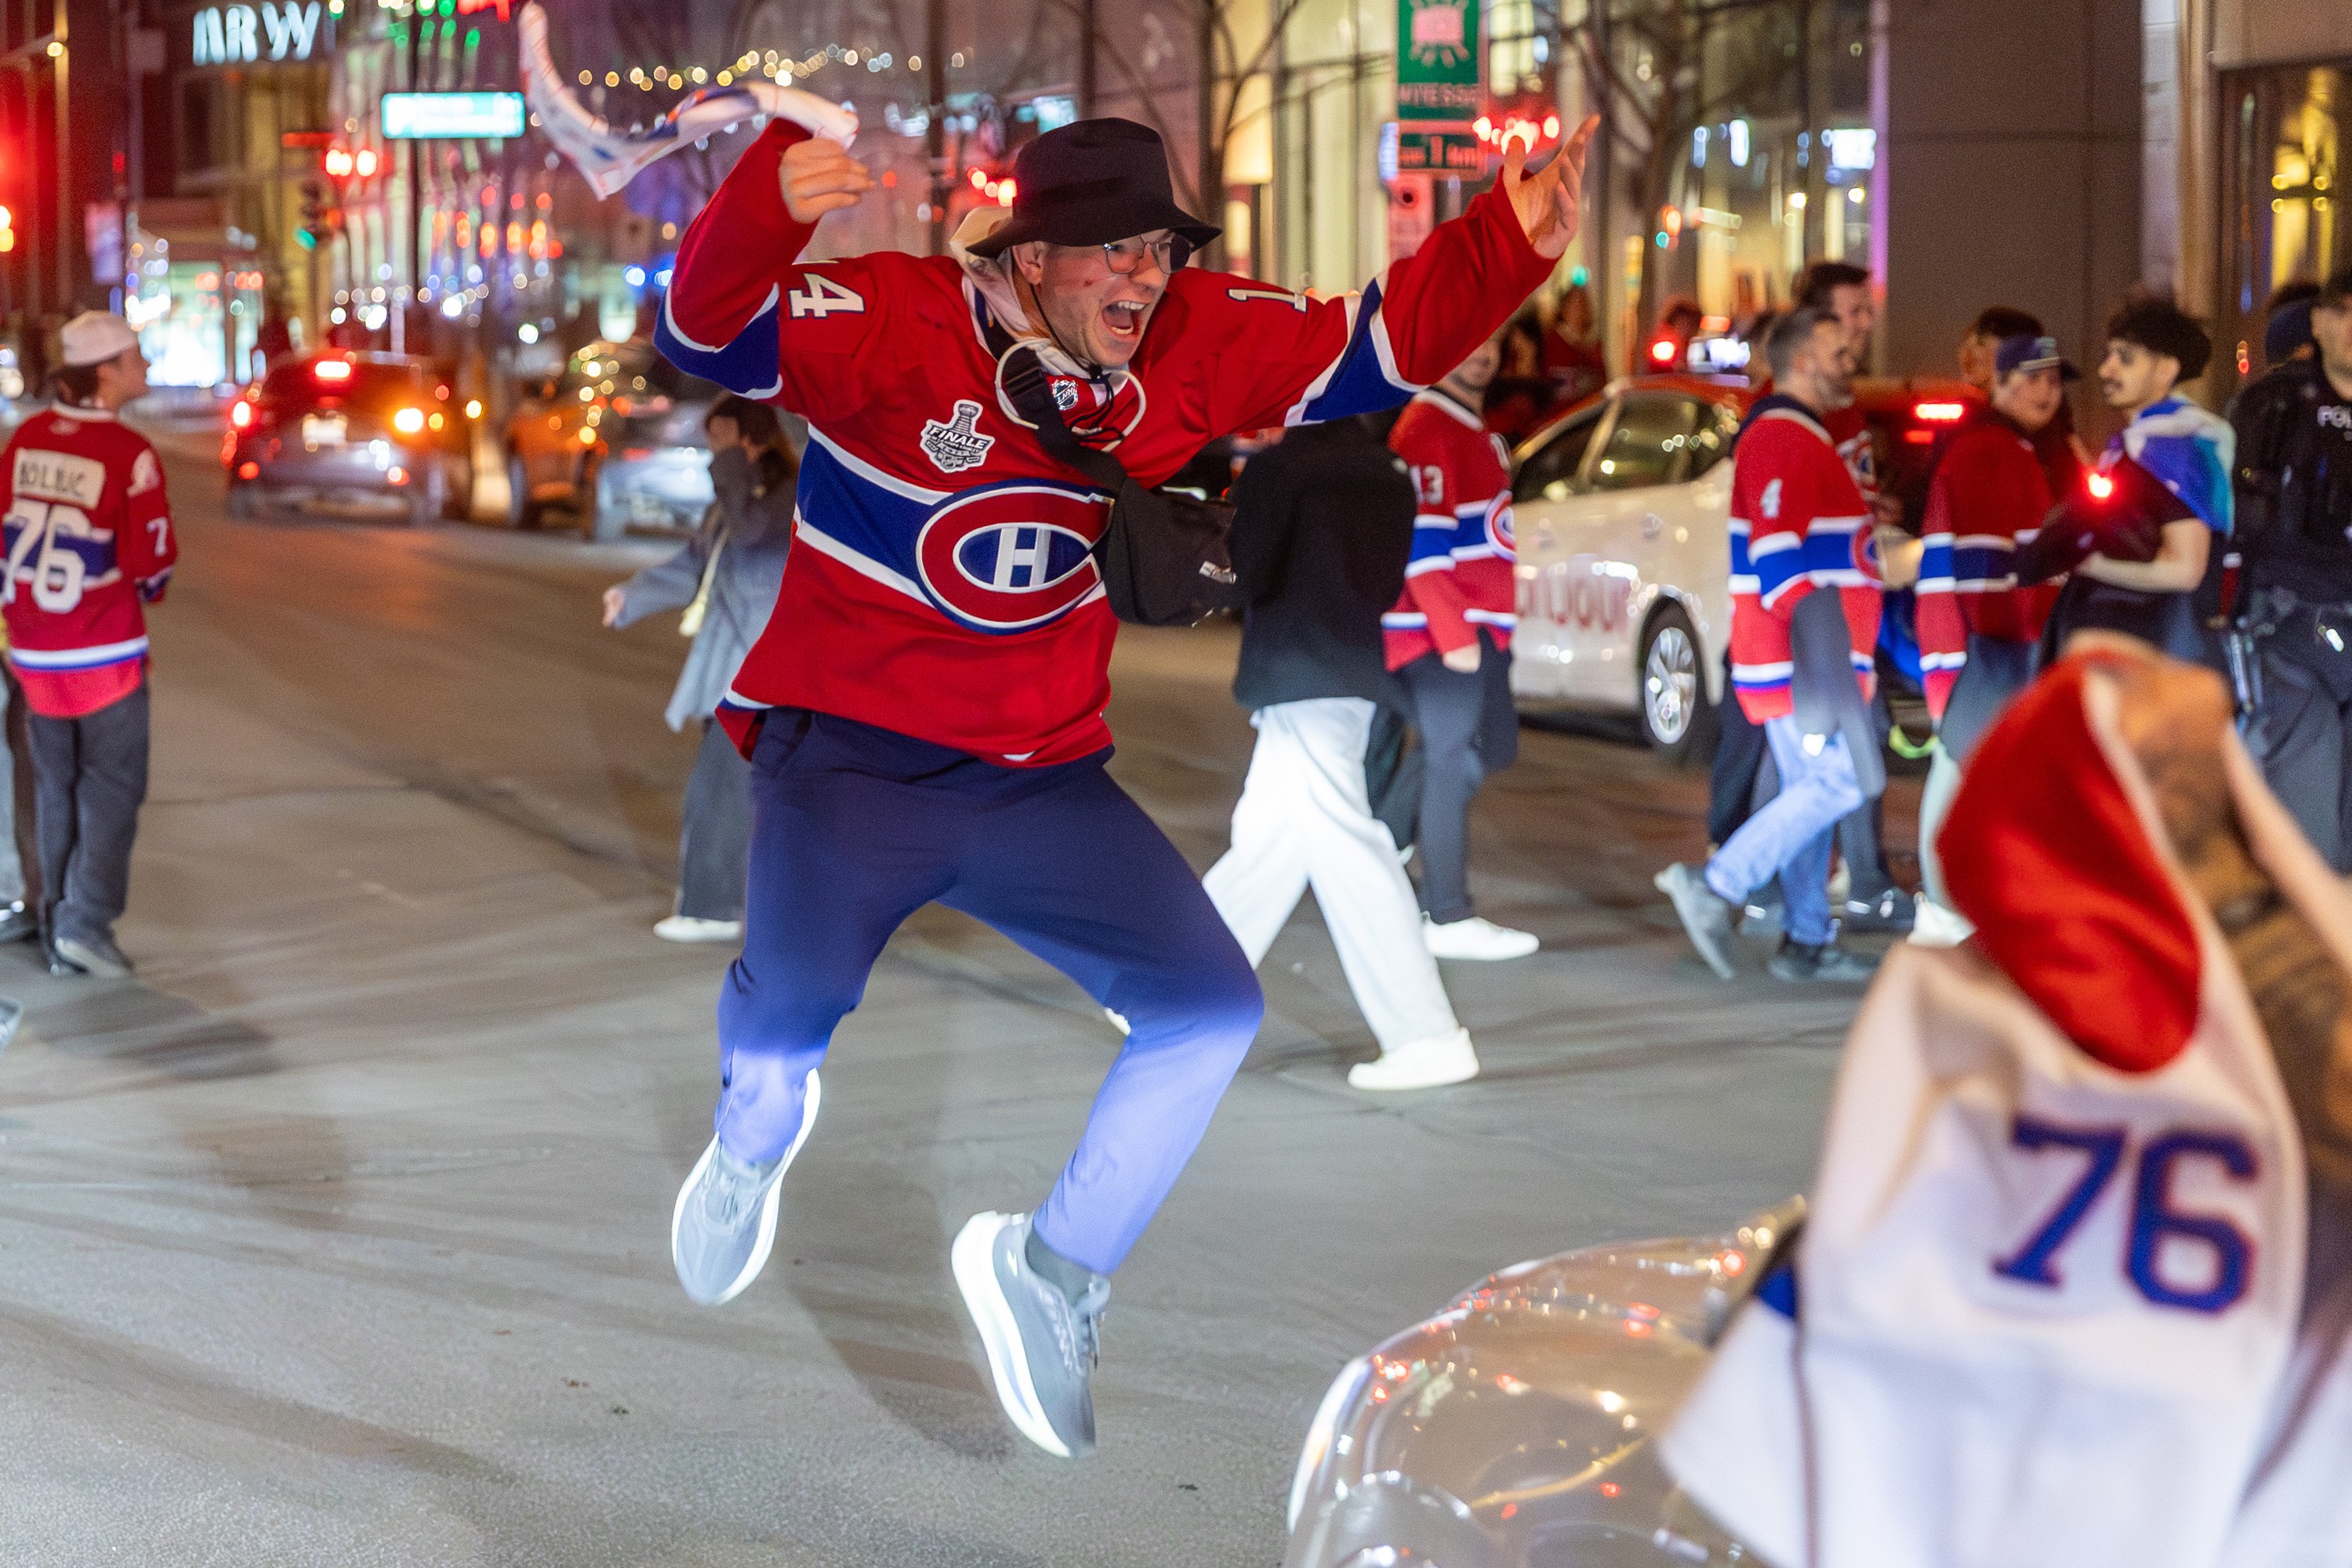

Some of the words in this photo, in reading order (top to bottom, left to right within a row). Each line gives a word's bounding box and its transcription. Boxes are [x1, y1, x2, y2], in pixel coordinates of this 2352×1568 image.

[929, 426, 988, 450] FINALE
[1759, 477, 1784, 518] 4
[1, 499, 88, 615] 76
[1991, 1116, 2261, 1314] 76
